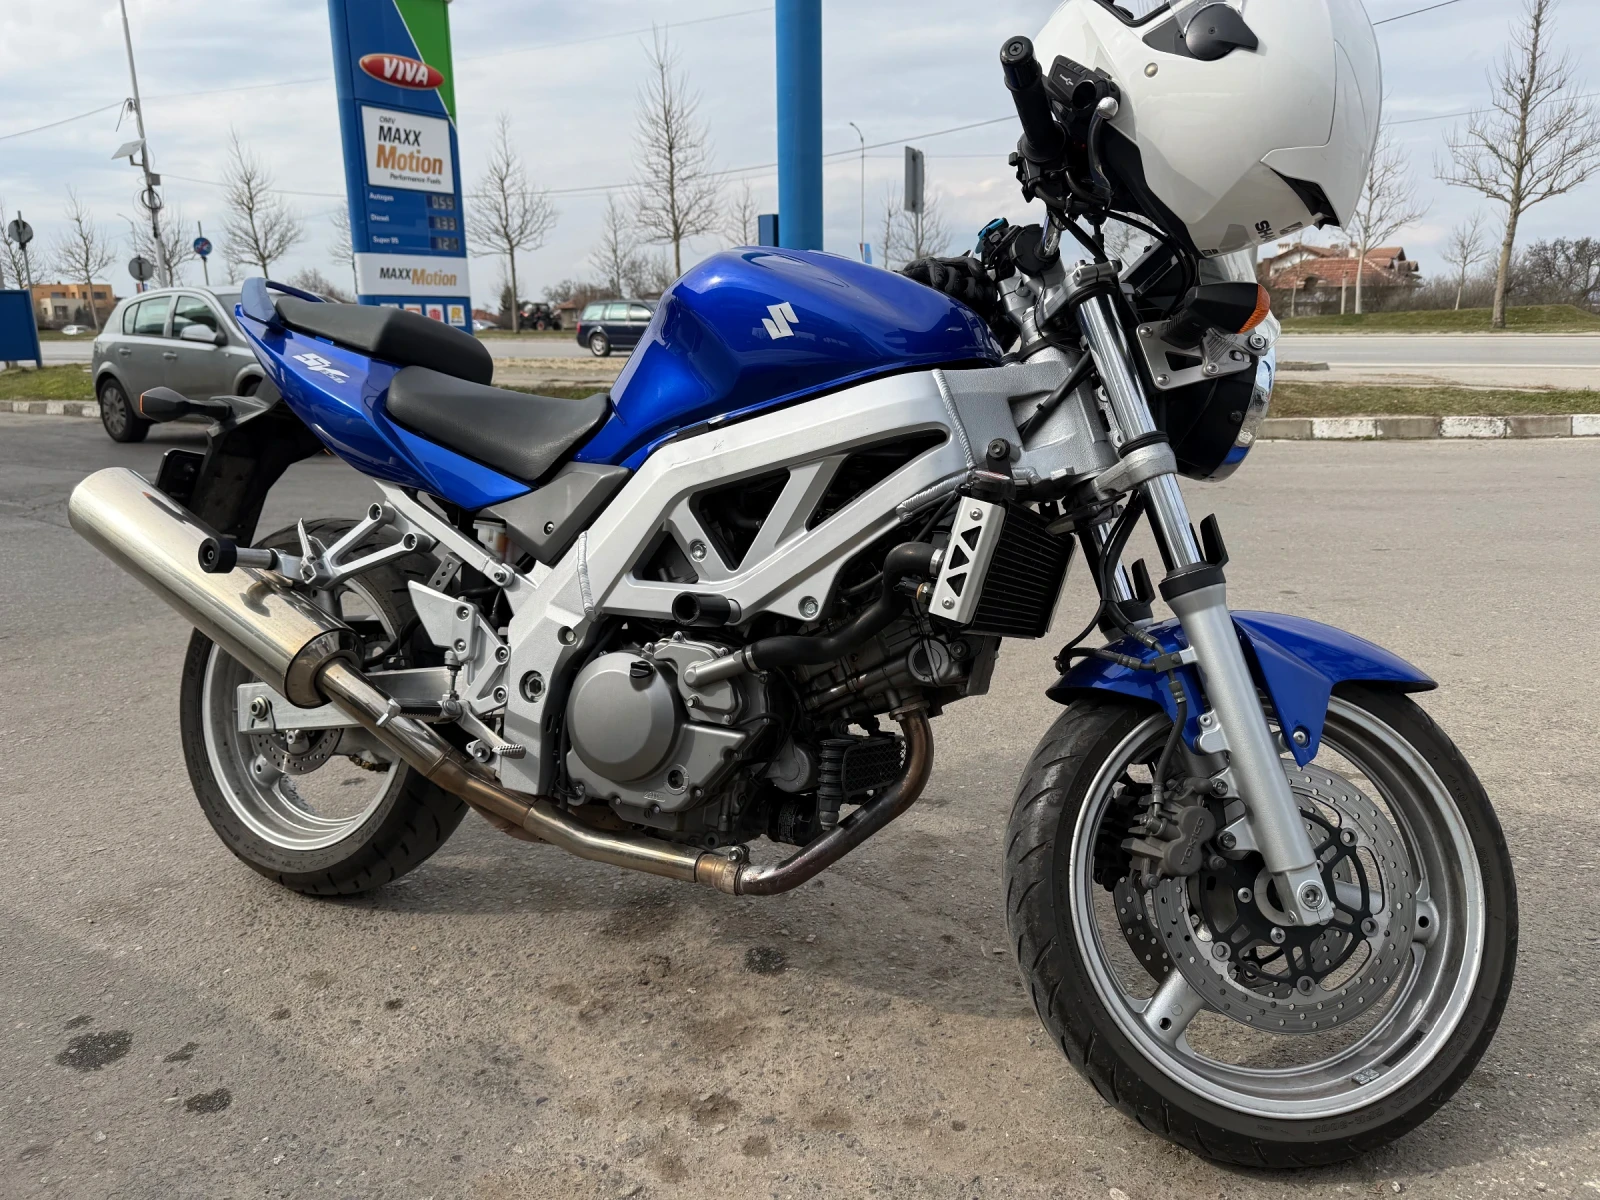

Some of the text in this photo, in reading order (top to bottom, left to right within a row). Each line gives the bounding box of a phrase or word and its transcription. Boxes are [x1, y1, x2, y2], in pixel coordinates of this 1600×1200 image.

[383, 56, 428, 86] VIVA
[378, 125, 422, 147] MAXX
[376, 143, 443, 175] Motion
[1180, 817, 1203, 865] TOKICO
